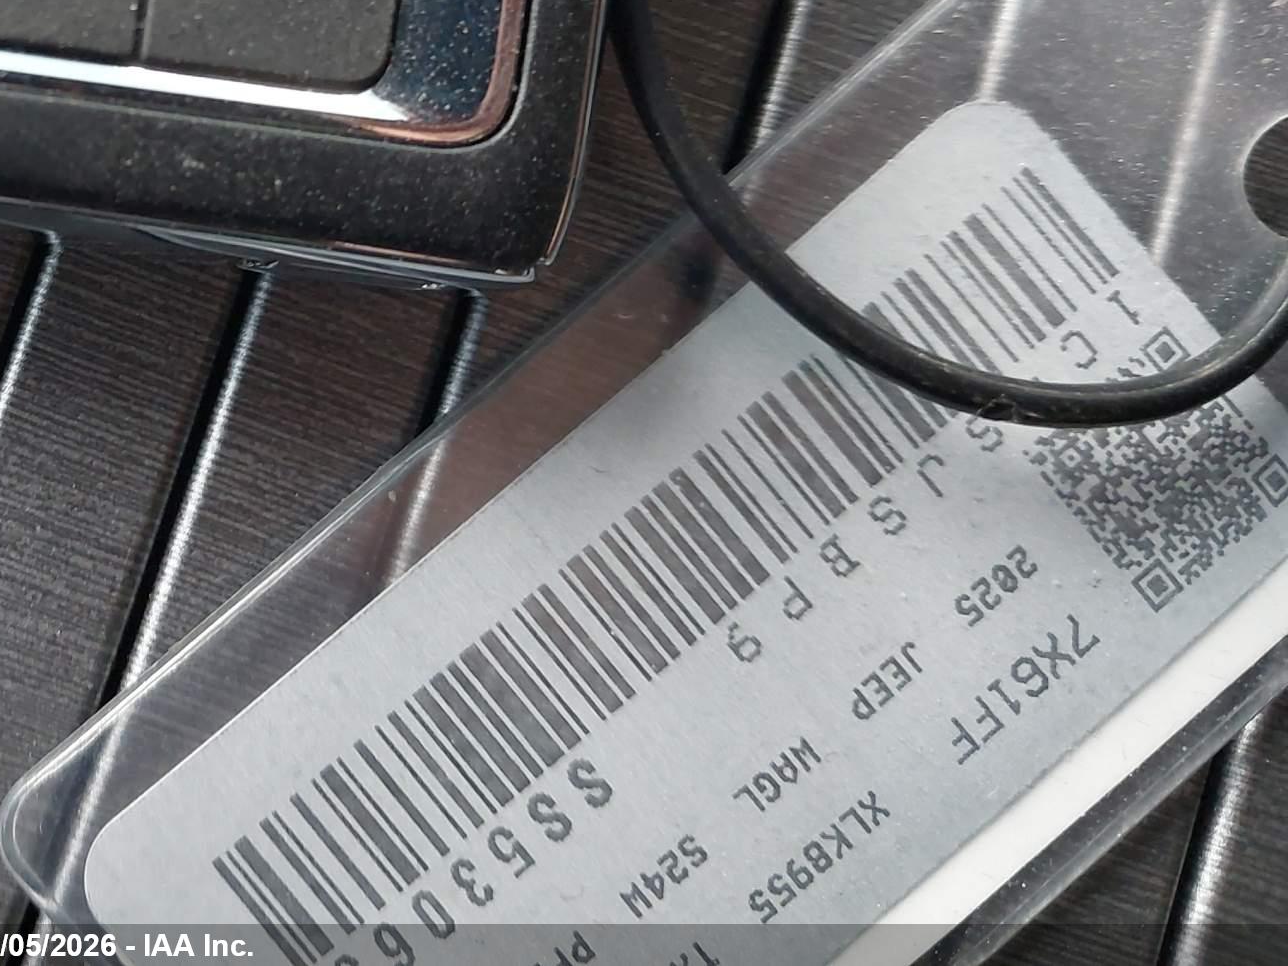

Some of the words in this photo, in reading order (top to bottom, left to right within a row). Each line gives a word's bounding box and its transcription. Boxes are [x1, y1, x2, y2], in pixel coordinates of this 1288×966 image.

[954, 545, 1038, 627] 2025
[851, 641, 923, 721] JEEP
[951, 613, 1101, 765] 7X61FF
[732, 735, 822, 812] WAGL
[619, 834, 709, 920] S24W
[747, 790, 891, 924] XLK8955
